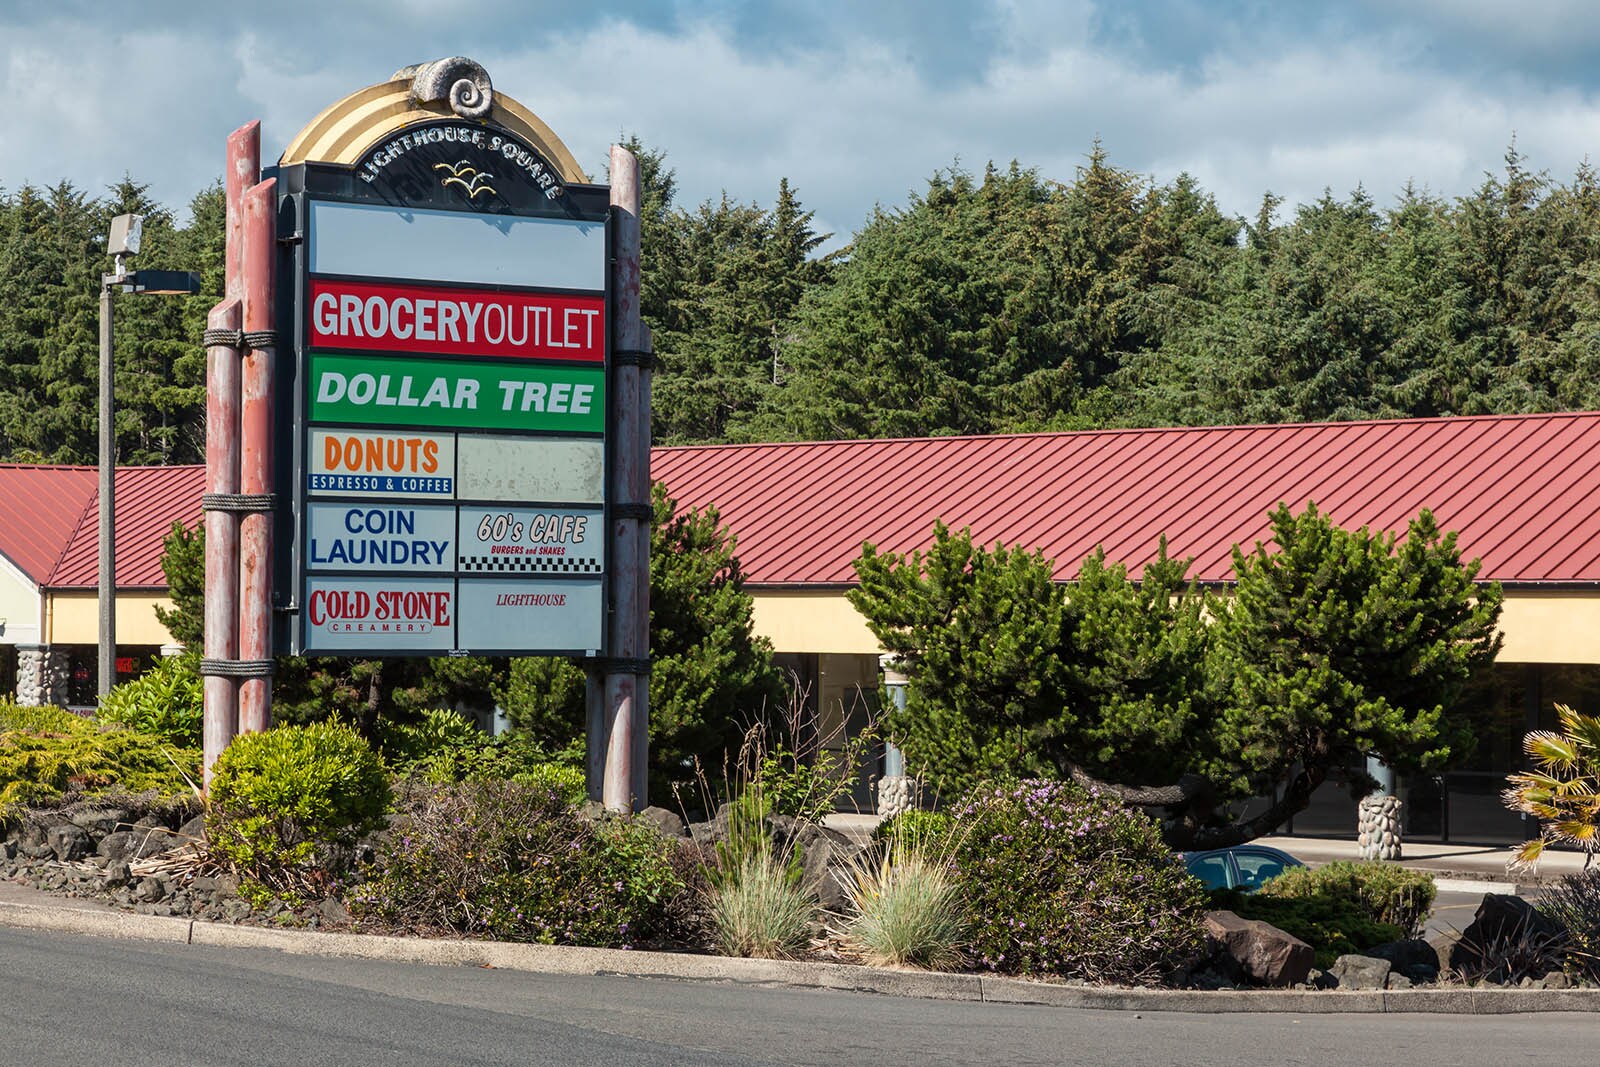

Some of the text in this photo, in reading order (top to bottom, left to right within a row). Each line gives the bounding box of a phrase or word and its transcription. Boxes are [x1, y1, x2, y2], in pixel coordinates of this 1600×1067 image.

[359, 127, 560, 200] LIGHTHOUSE SQUARE
[316, 371, 594, 414] DOLLAR TREE
[324, 436, 439, 474] DONUTS
[312, 475, 449, 492] ESPRESSO & COFFEE
[344, 509, 415, 535] COIN
[477, 513, 588, 544] 60's CAFE
[311, 538, 449, 565] LAUNDRY
[490, 545, 566, 556] BURGERS and SHAKES
[309, 589, 450, 627] COLD STONE
[496, 593, 567, 606] LIGHTHOUSE
[332, 623, 426, 632] CREAMERY
